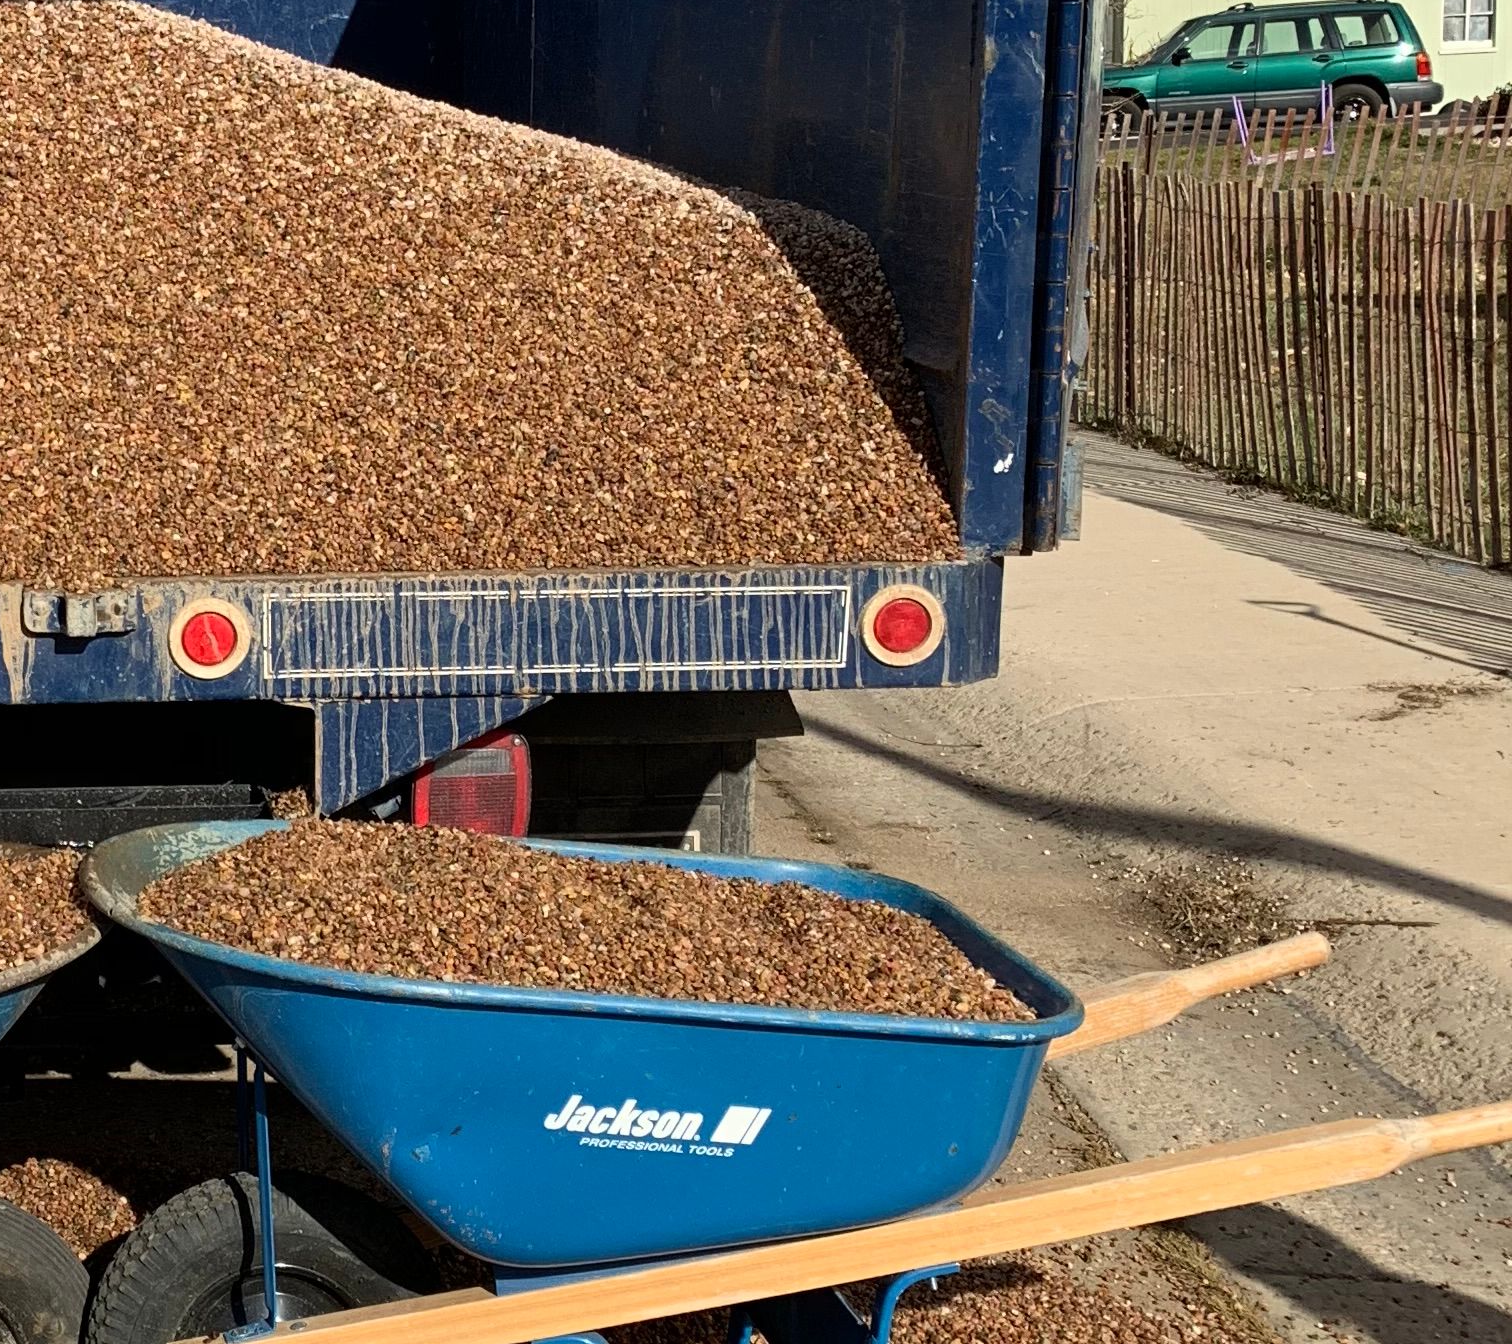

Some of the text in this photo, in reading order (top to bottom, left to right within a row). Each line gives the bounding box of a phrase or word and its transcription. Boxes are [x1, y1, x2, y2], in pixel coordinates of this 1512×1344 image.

[544, 1094, 704, 1141] Jackson
[579, 1136, 735, 1158] PROFESSIONAL TOOLS
